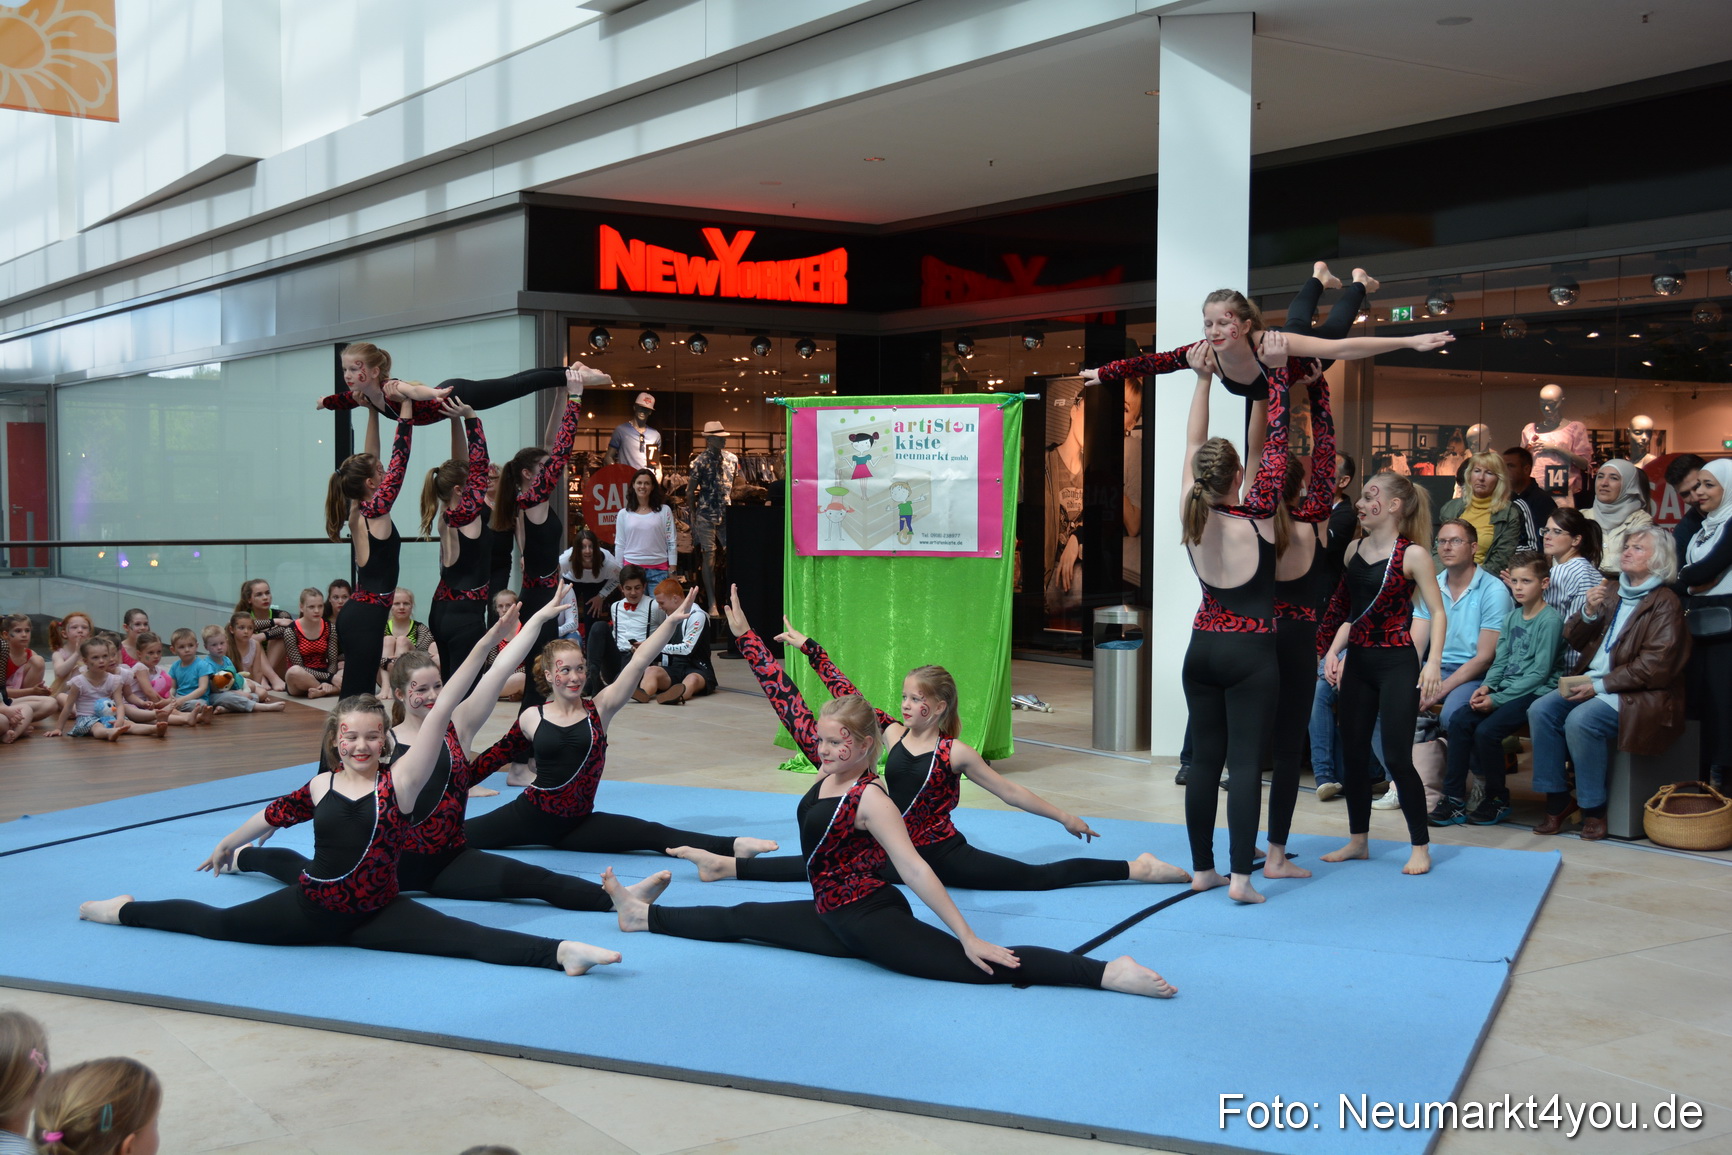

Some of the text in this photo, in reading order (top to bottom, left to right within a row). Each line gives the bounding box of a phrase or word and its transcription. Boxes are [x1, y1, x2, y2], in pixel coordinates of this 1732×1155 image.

[896, 434, 941, 450] kiste
[895, 451, 949, 461] neumarkt
[592, 482, 628, 511] SAL
